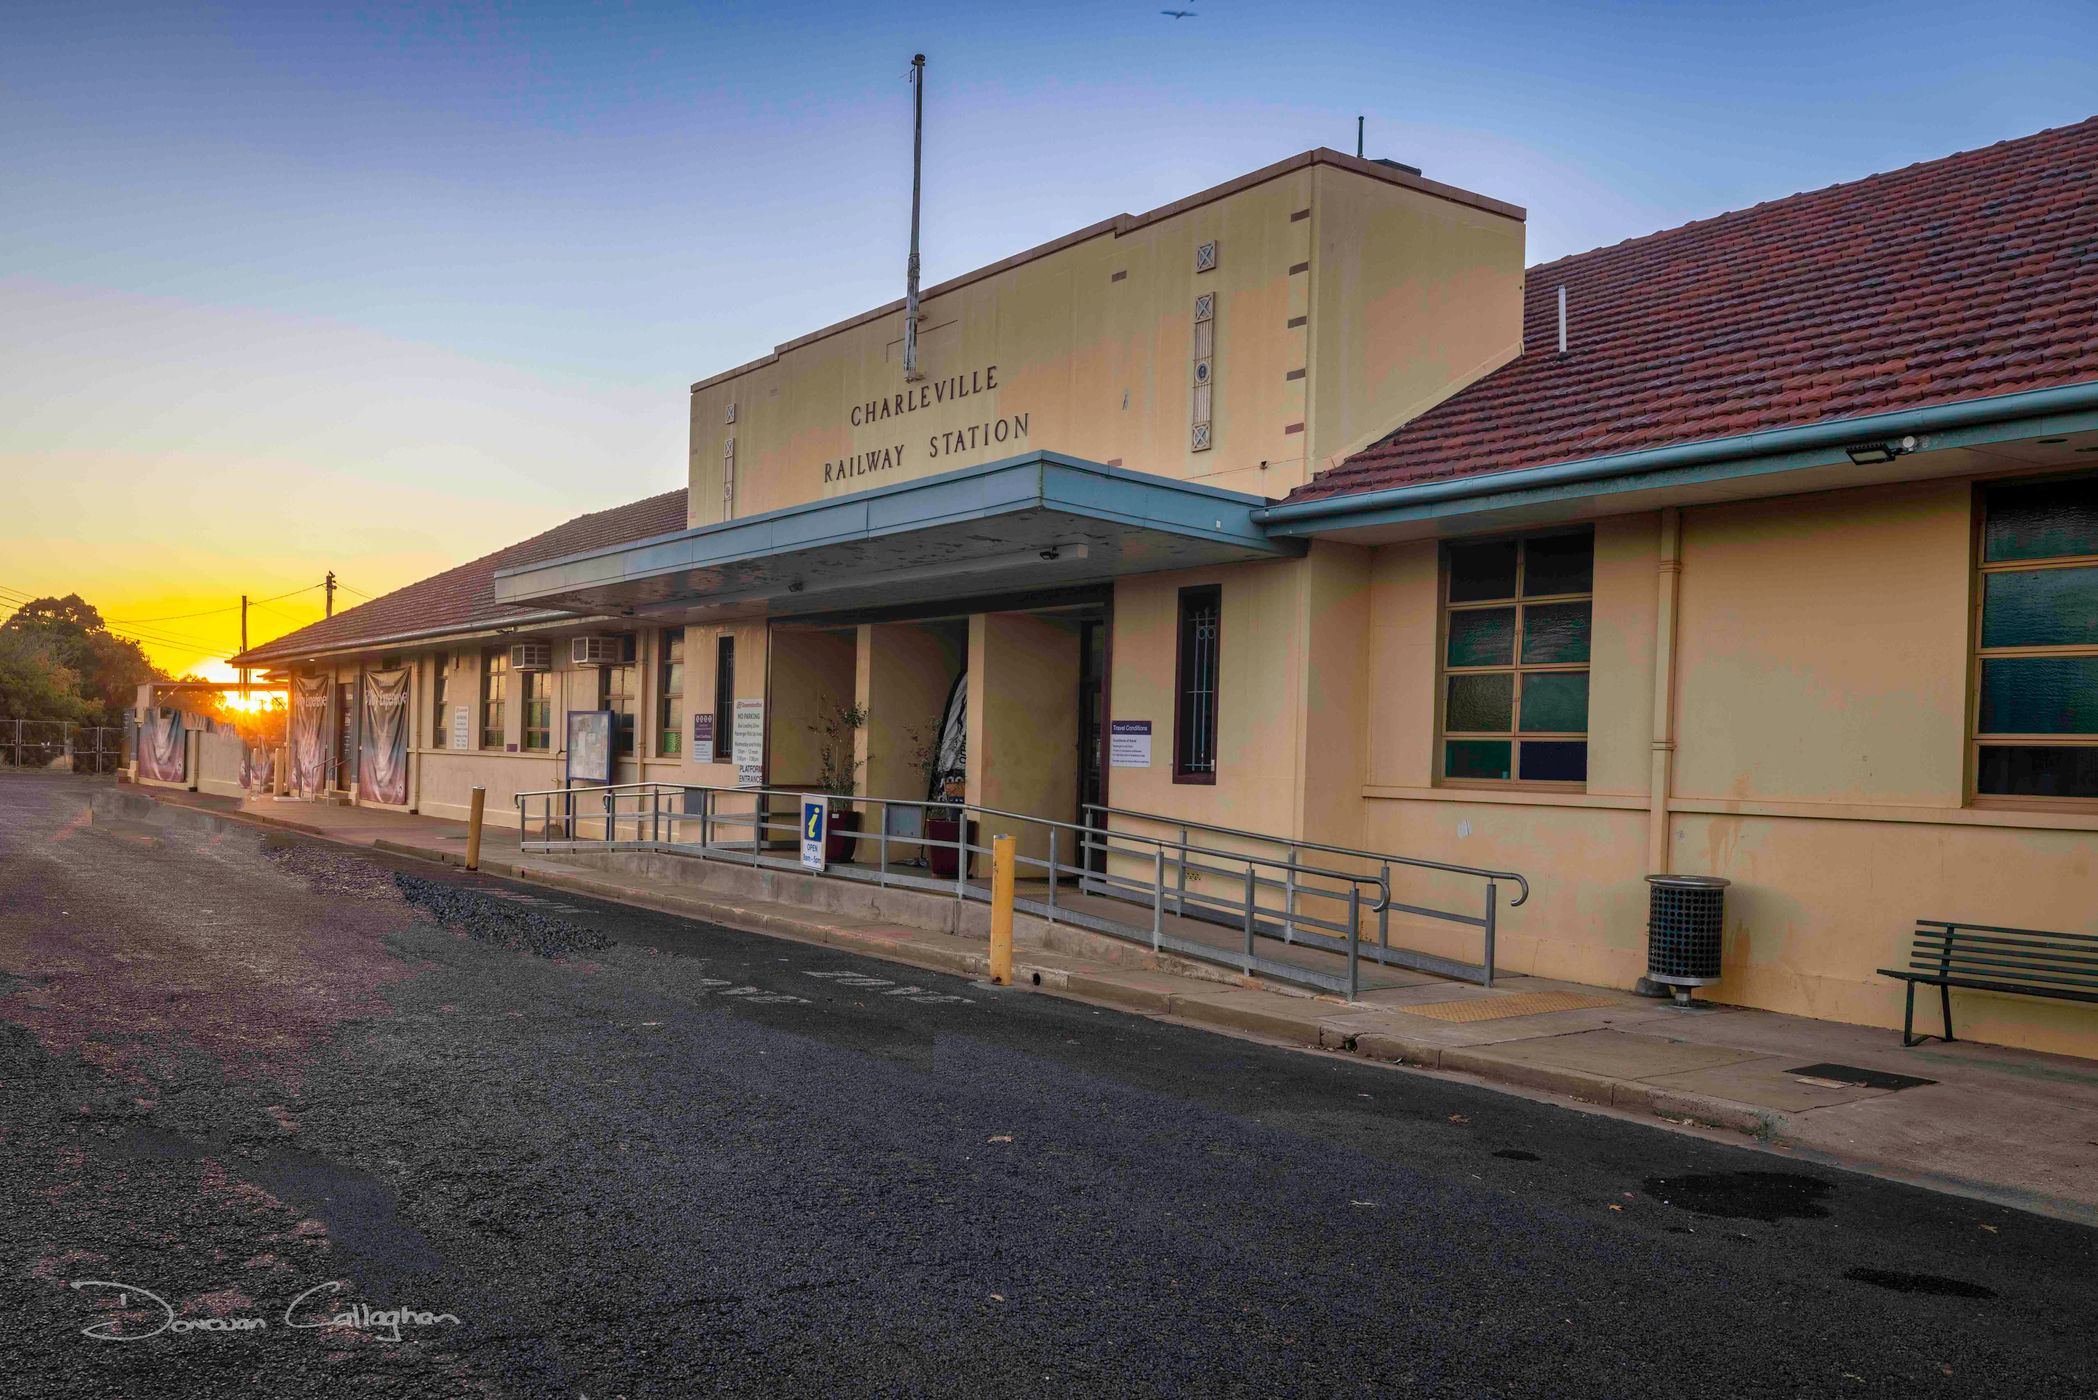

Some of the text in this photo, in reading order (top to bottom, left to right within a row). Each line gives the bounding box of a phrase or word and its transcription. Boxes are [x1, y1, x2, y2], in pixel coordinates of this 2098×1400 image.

[850, 365, 998, 427] CHARLEVILLE
[824, 412, 1029, 483] RAILWAY STATION
[744, 712, 761, 720] PARKING
[739, 764, 763, 774] PLATFORM
[739, 774, 763, 783] ENTRANCE
[807, 843, 818, 852] OPEN
